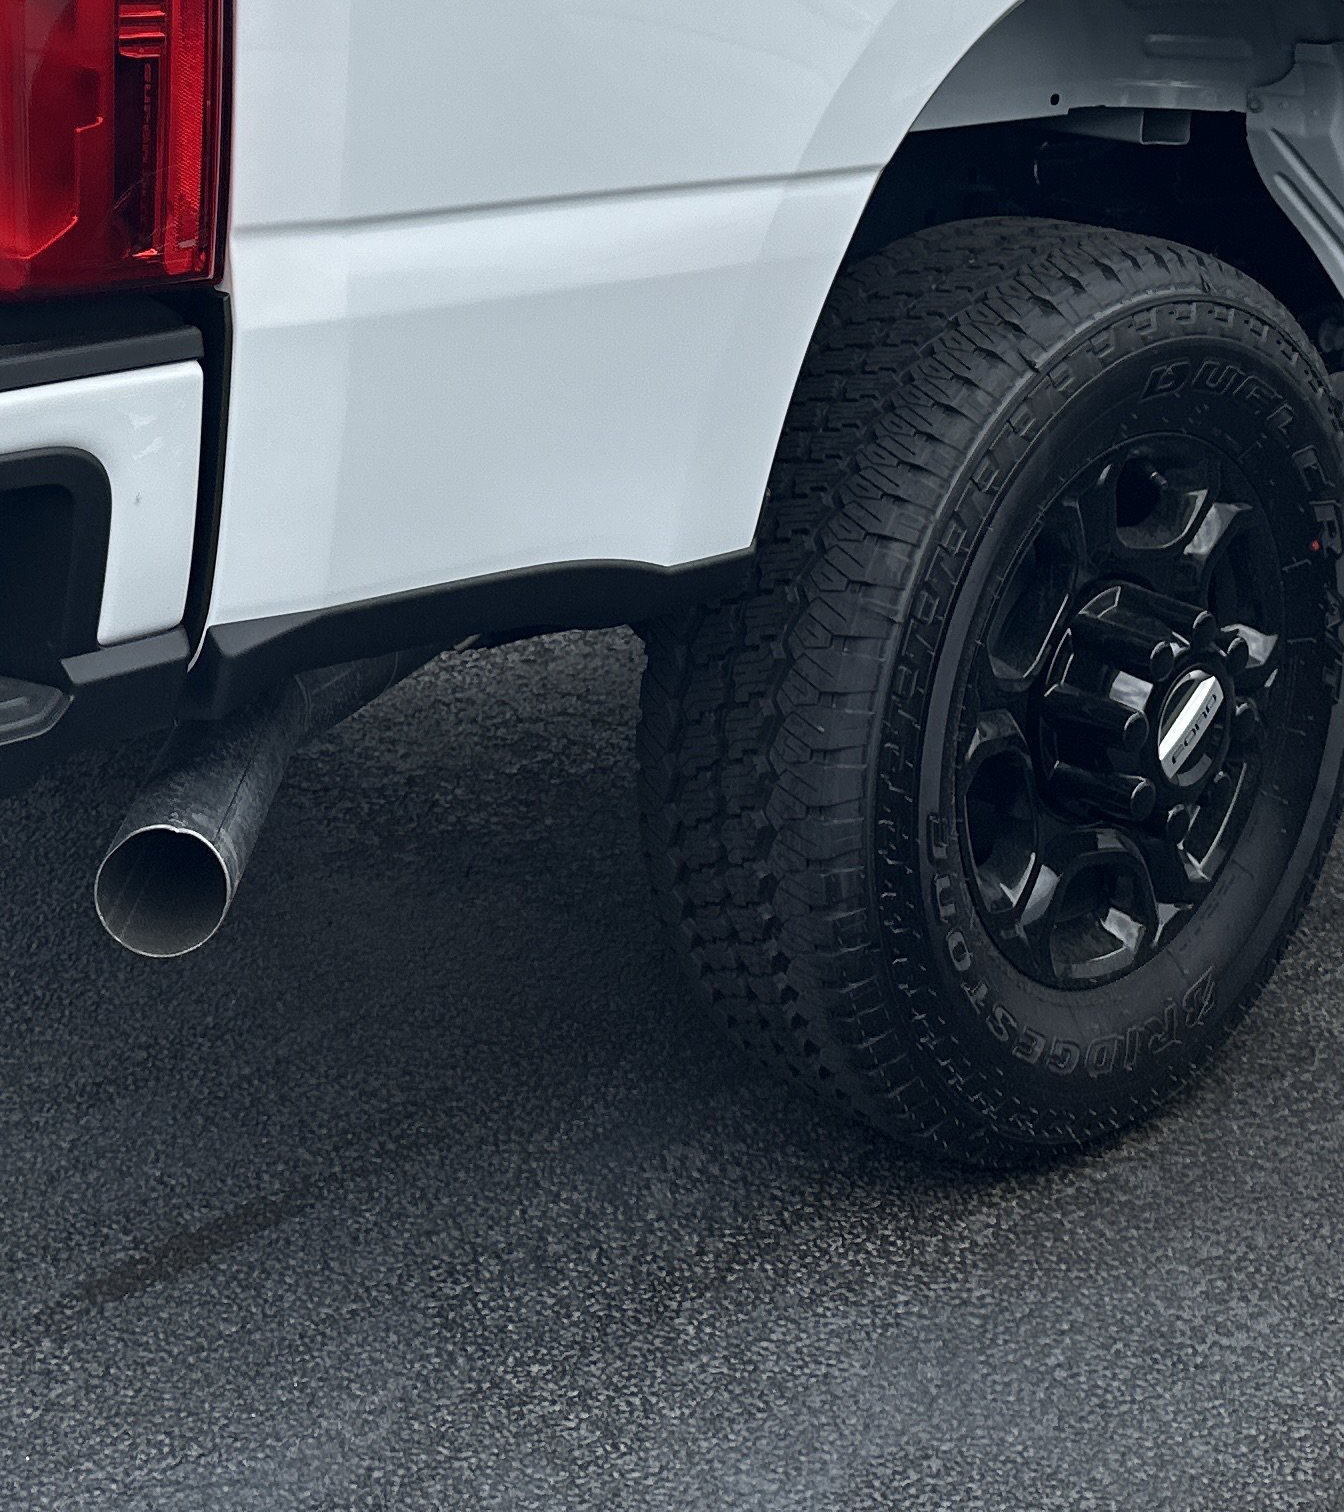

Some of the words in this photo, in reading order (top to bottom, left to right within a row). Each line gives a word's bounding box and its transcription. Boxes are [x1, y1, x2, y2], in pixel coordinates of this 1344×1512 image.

[1138, 358, 1344, 560] DUELER
[1170, 693, 1218, 765] FORD
[927, 813, 1217, 1077] BRIDGESTONE
